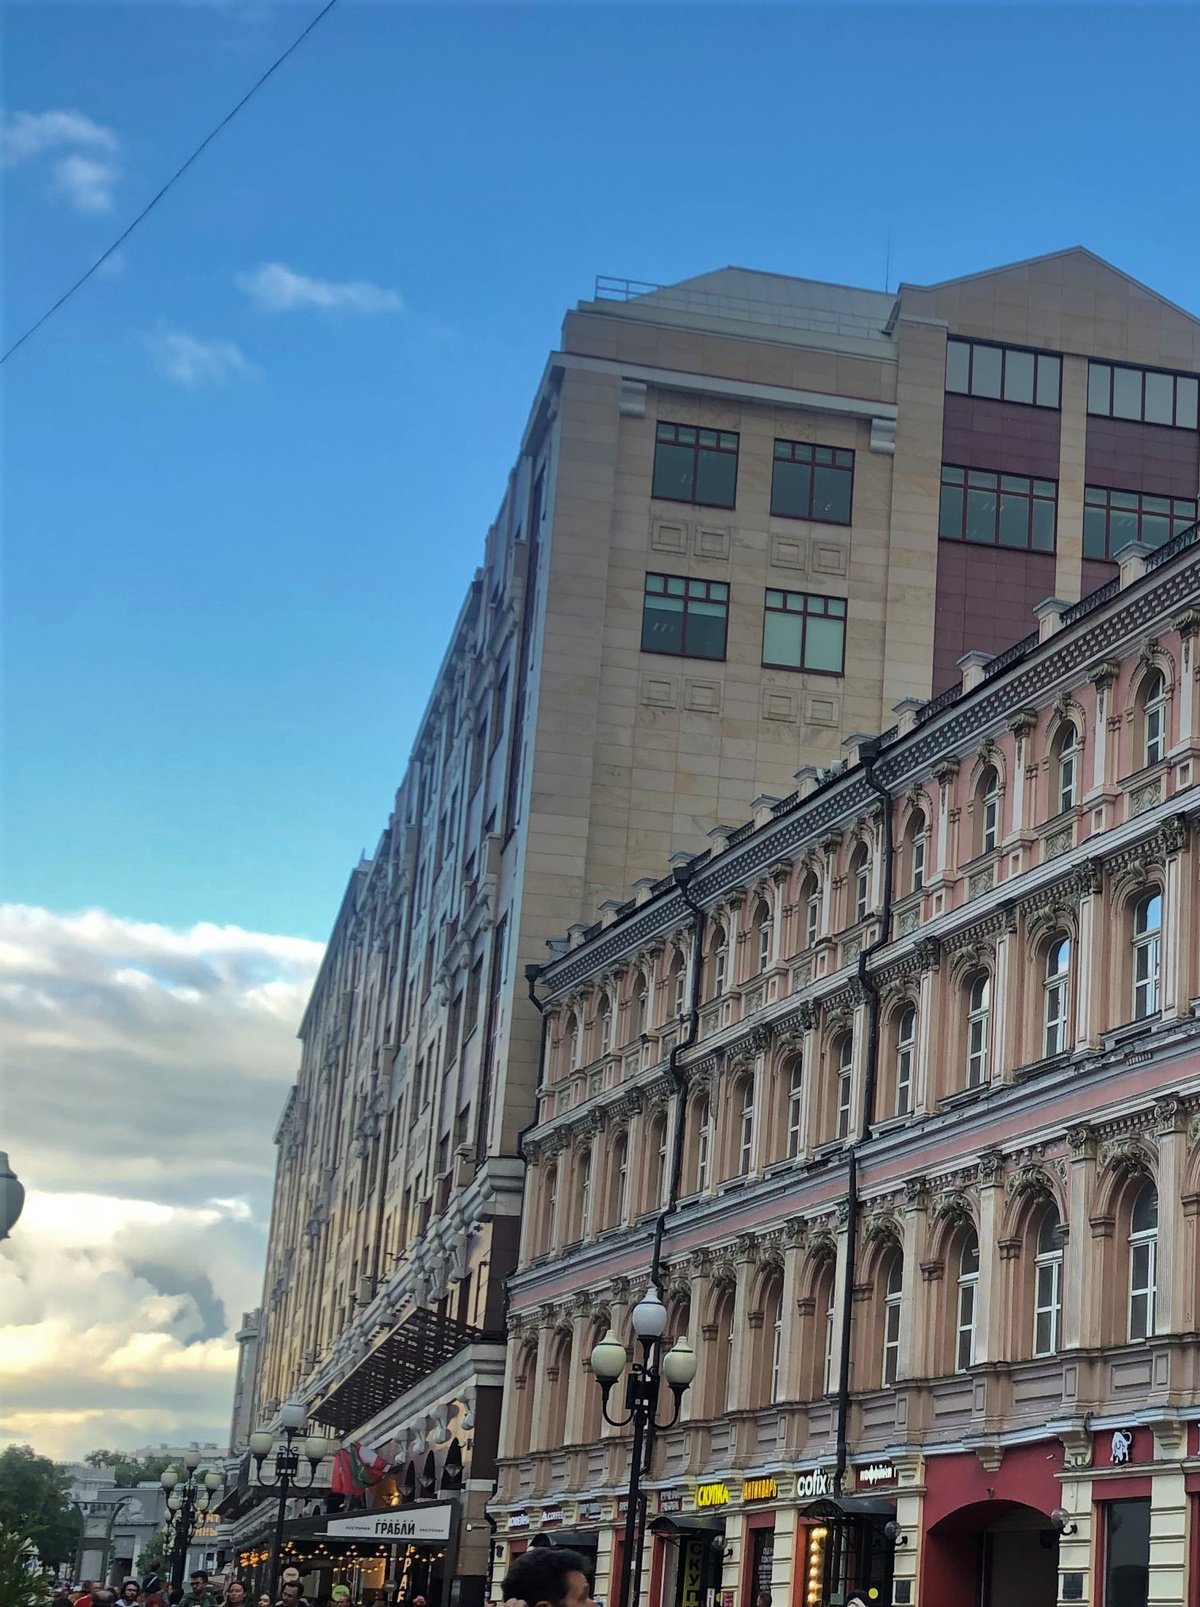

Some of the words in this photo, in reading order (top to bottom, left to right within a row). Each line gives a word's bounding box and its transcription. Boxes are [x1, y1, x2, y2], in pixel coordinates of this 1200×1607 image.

[797, 1469, 827, 1496] cofix
[698, 1483, 729, 1507] СКУПКА
[374, 1522, 416, 1535] ГРАБЛИ
